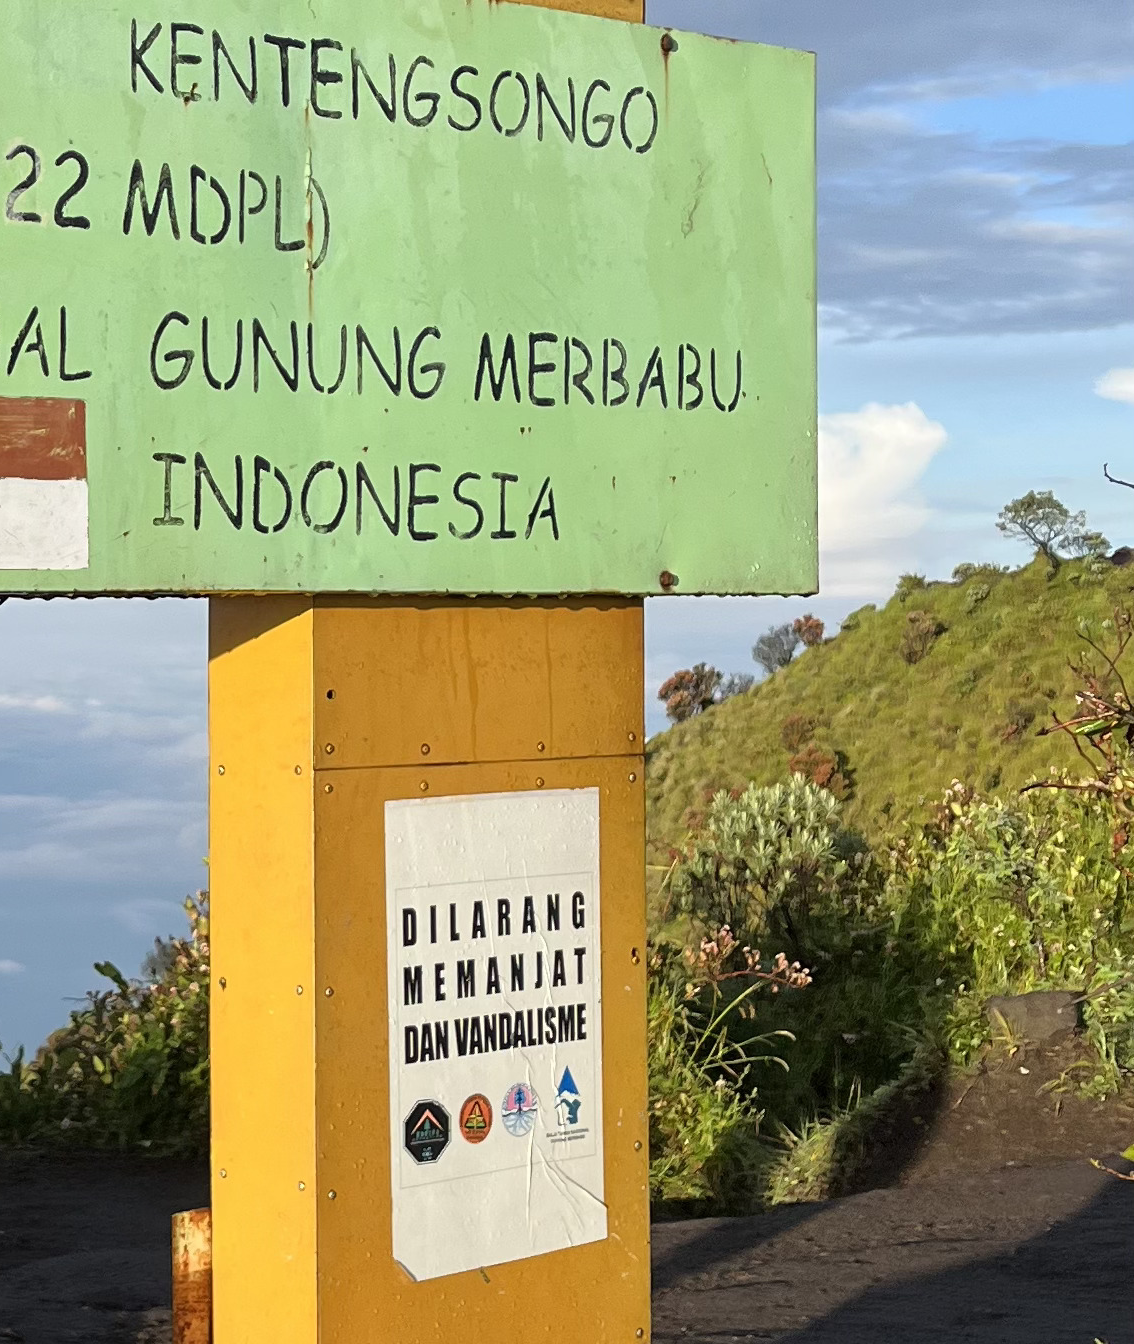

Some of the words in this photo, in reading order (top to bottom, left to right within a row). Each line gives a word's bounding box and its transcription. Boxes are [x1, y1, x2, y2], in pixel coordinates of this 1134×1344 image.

[129, 16, 660, 154] KENTENGSONGO
[122, 158, 331, 270] MDPL)
[150, 312, 446, 402] GUNUNG
[474, 332, 744, 413] MERBABU
[152, 452, 561, 542] INDONESIA
[402, 891, 586, 947] DILARANG
[403, 947, 586, 1006] MEMANJAT
[404, 1019, 449, 1065] DAN
[454, 1003, 587, 1057] VANDALISME
